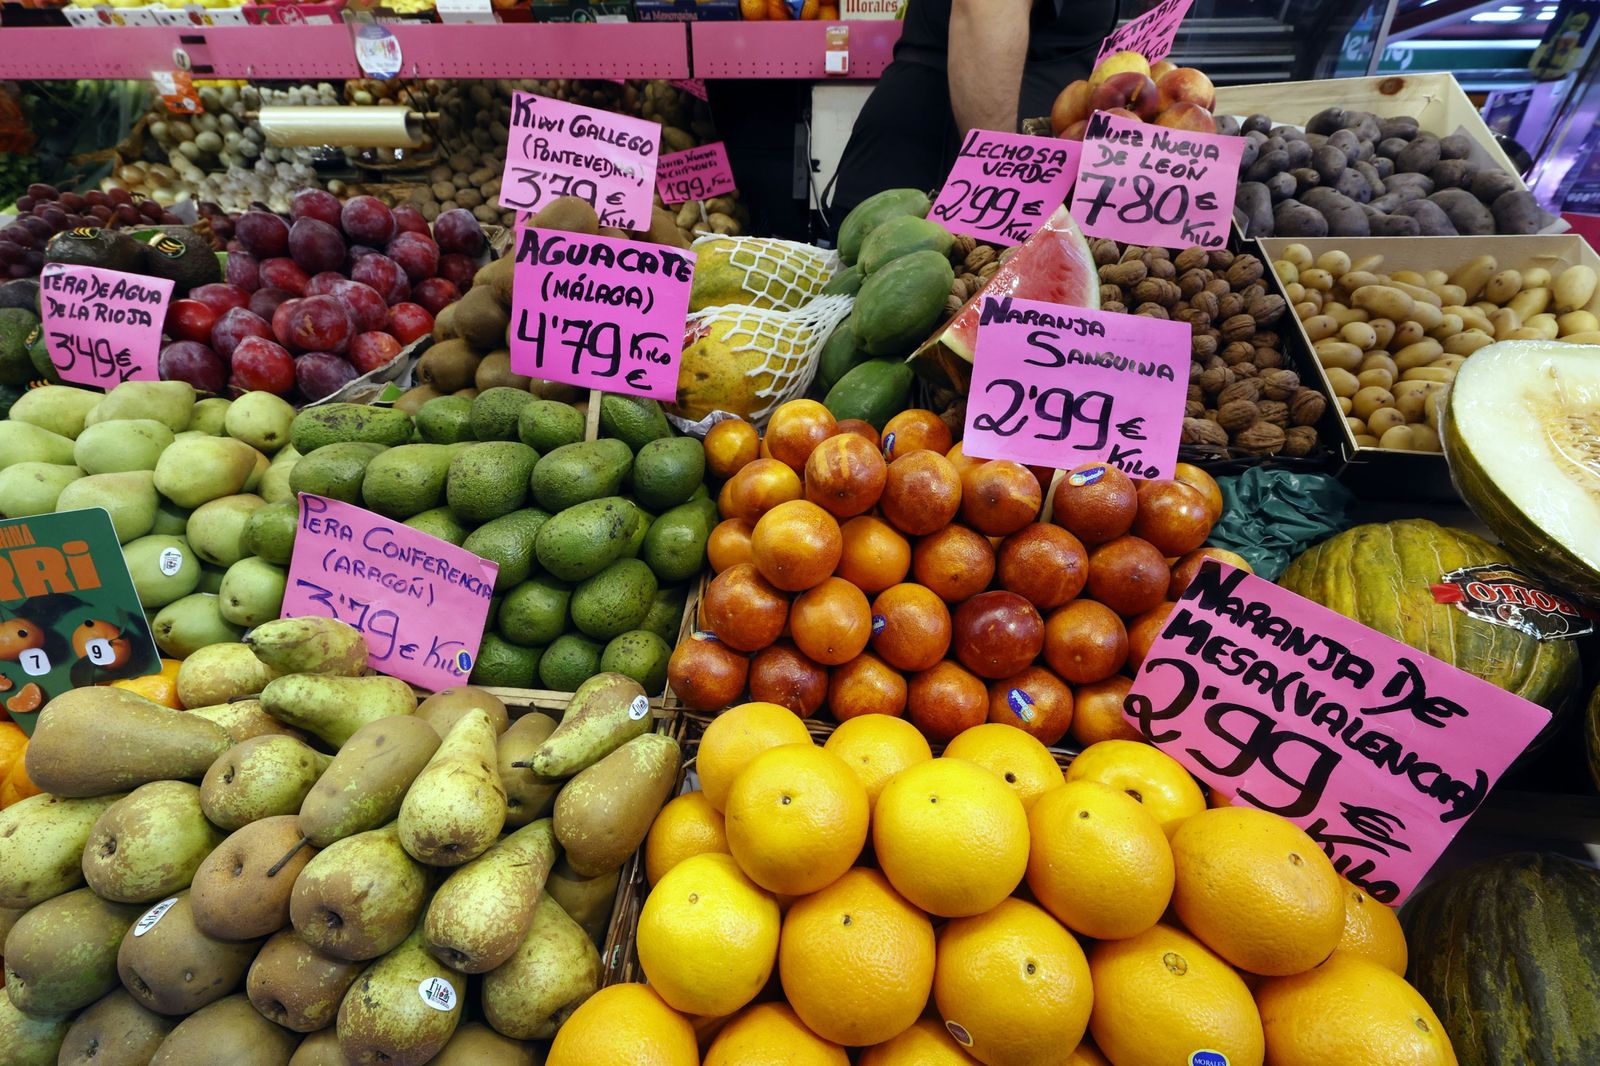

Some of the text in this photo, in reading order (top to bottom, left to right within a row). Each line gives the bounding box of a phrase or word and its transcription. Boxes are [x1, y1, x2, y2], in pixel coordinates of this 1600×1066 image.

[513, 94, 654, 157] KIWI GALLEGO
[1085, 114, 1220, 162] NUEZ NUEVA
[523, 134, 644, 187] (PONTEVEDRA)
[959, 131, 1067, 167] LECHOSA
[1092, 144, 1208, 181] DE LEÓN
[983, 162, 1063, 184] VERDE
[606, 192, 626, 205] €
[934, 179, 1045, 230] 2'99 €
[1077, 171, 1219, 226] 7'80 €
[516, 229, 692, 282] AGUACATE
[46, 296, 152, 327] DE LA RIOJA
[83, 274, 110, 303] DE
[110, 279, 162, 304] AGUA
[541, 272, 654, 315] (MÁLAGA)
[980, 296, 1105, 338] NARANJA
[115, 348, 132, 367] €
[517, 308, 622, 377] 4'79
[1023, 331, 1174, 382] SANGUINA
[625, 369, 653, 390] €
[973, 379, 1147, 450] 2'99 €
[302, 494, 494, 600] PERA CONFERENCIA
[29, 645, 102, 669] 7 9
[400, 643, 420, 660] €
[1181, 560, 1470, 728] NARANJA DE
[1339, 801, 1411, 852] €
